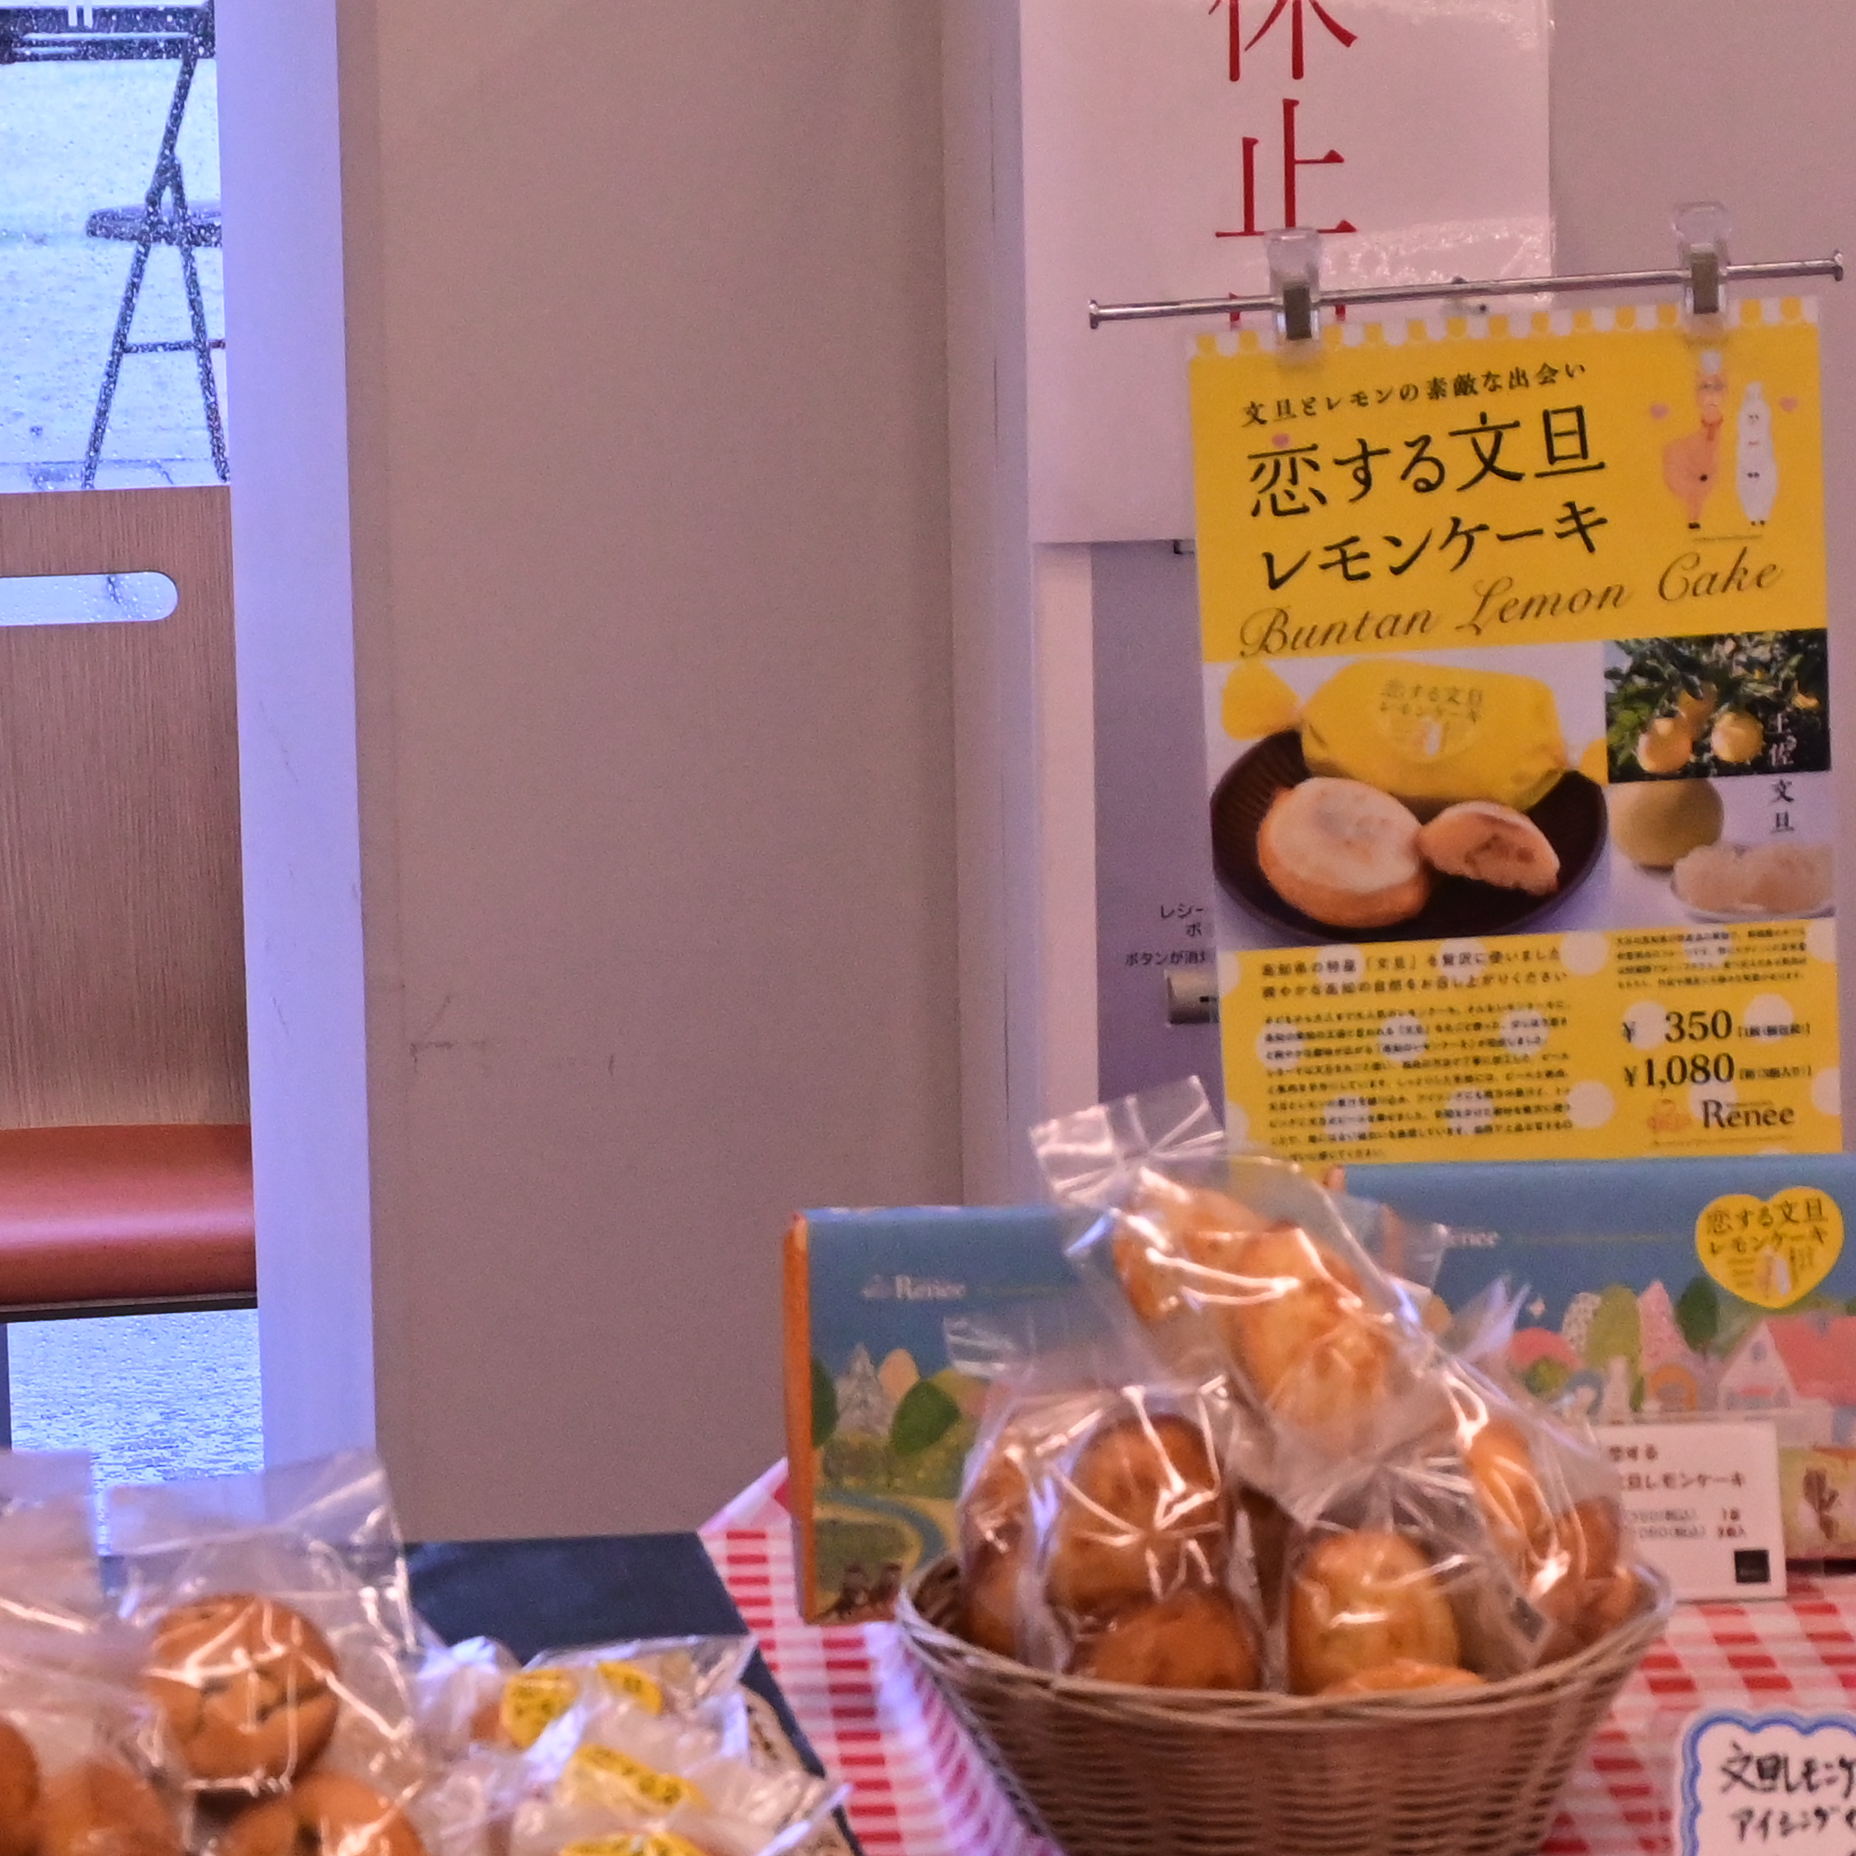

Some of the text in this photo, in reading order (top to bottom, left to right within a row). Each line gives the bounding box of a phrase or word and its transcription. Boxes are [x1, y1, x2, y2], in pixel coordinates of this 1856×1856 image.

[1242, 361, 1587, 428] 文旦とレモンの素敵な出会い
[1246, 405, 1607, 518] 恋する文旦
[1260, 501, 1608, 592] レモンケーキ
[1240, 547, 1784, 659] Buntan Lemon Cake
[1664, 1009, 1733, 1043] 350
[1623, 1052, 1735, 1089] ¥1,080
[1702, 1098, 1795, 1129] Renee
[1620, 1471, 1746, 1491] 旦レモンケーキ
